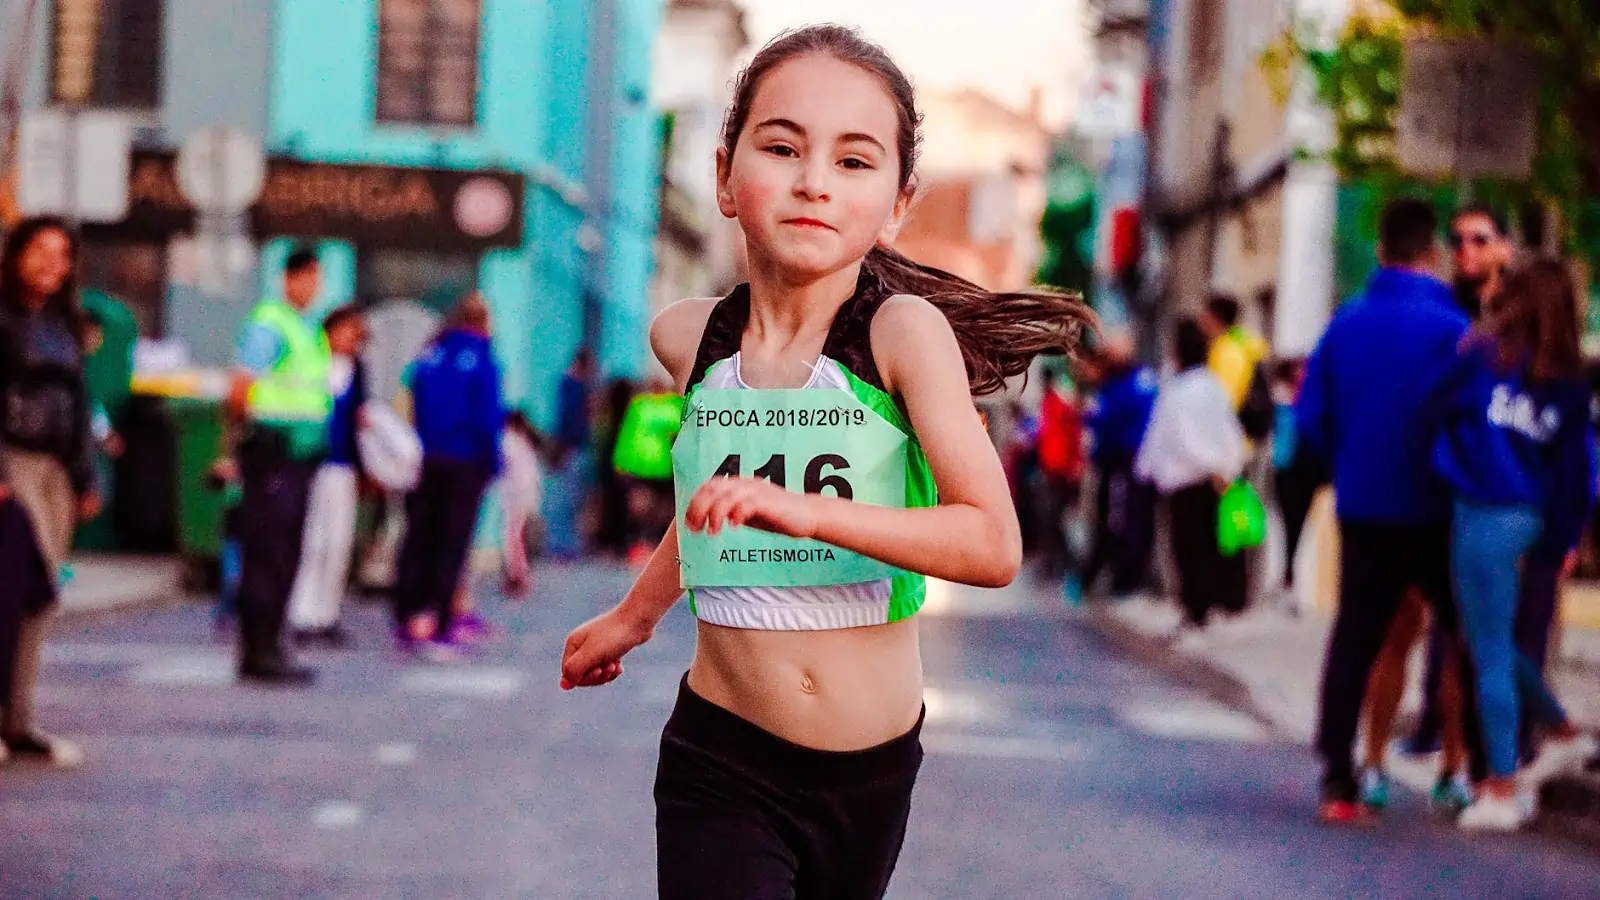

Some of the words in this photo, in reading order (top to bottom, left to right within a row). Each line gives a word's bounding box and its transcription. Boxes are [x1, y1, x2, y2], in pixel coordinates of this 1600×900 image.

[697, 406, 760, 427] ÉPOCA
[765, 409, 864, 426] 2018/2019
[719, 548, 836, 562] ATLETISMOITA
